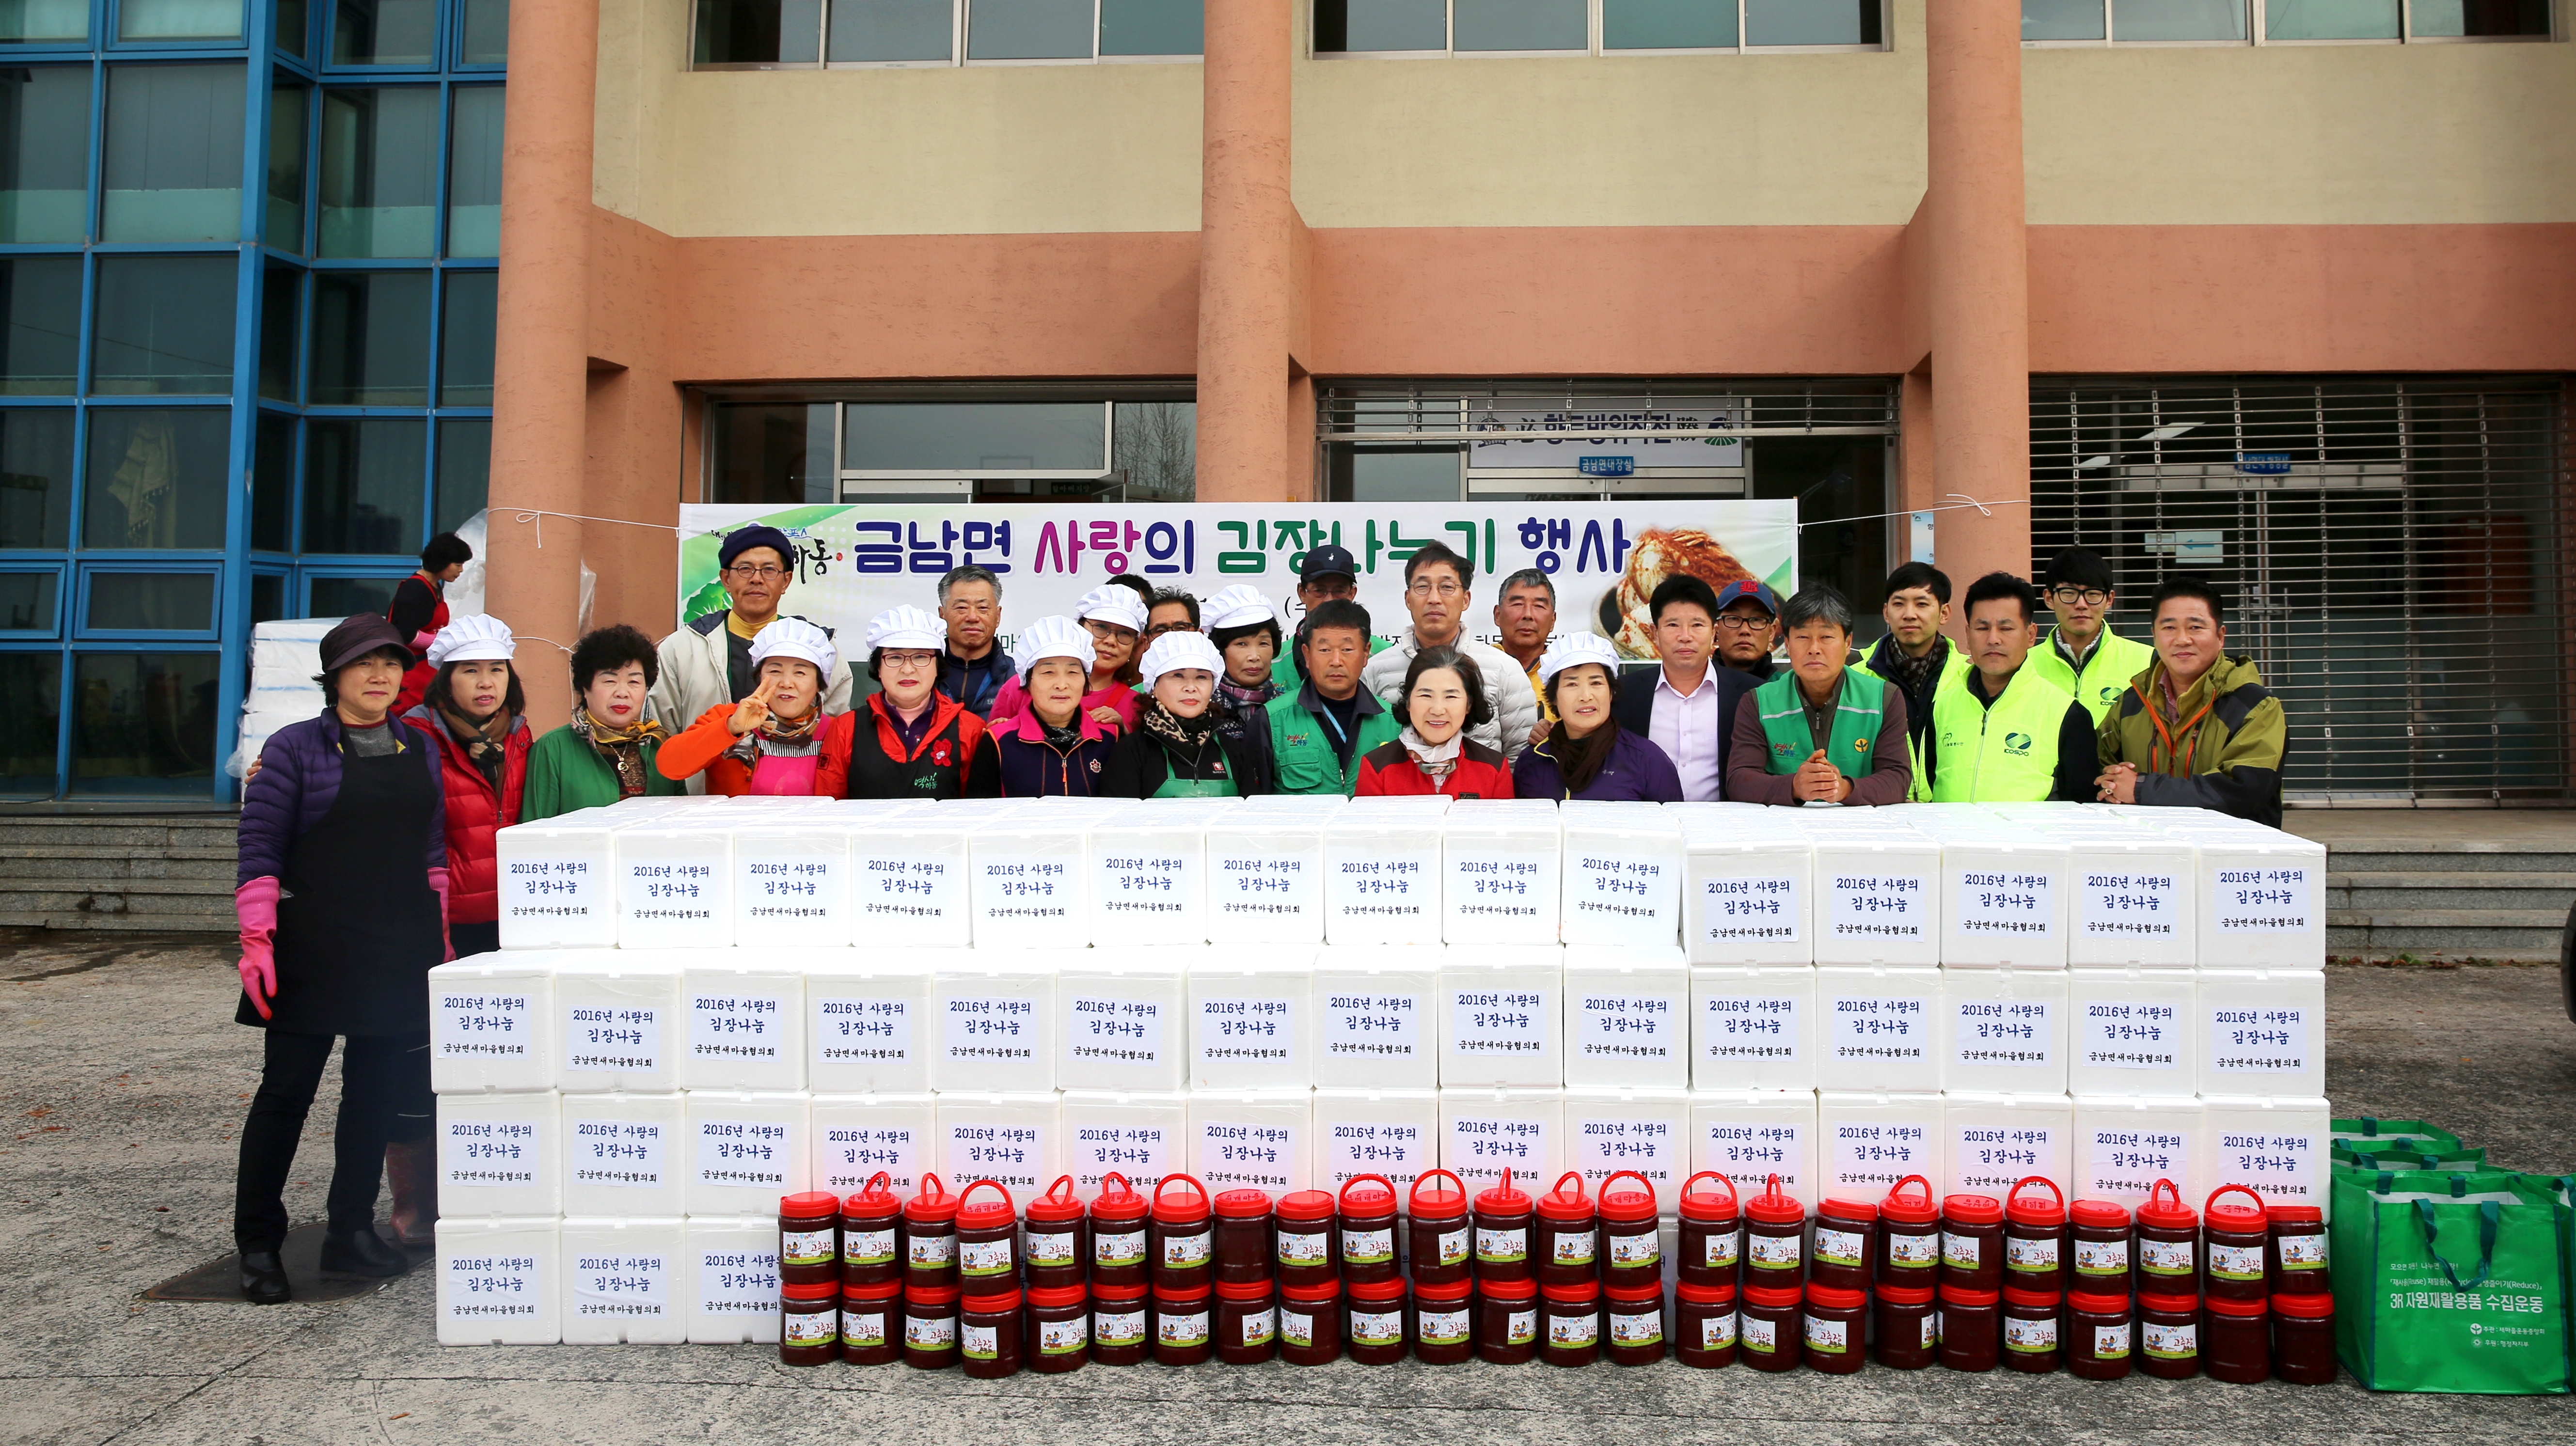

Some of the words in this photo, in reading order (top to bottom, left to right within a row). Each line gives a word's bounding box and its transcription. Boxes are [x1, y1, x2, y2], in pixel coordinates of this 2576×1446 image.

[1581, 458, 1632, 472] 금남면대장실
[855, 520, 1011, 574] 금남면
[1035, 519, 1194, 575] 사랑의
[1518, 517, 1631, 575] 행사
[914, 772, 937, 789] 역시!
[925, 781, 938, 790] 하동
[511, 863, 548, 875] 2016년
[554, 862, 586, 875] 사랑의
[751, 863, 787, 876] 2016년
[793, 864, 826, 876] 사랑의
[987, 864, 1024, 876] 2016년
[1030, 864, 1062, 876] 사랑의
[1224, 860, 1261, 872] 2016년
[1268, 861, 1300, 873] 사랑의
[1342, 862, 1379, 874] 2016년
[1386, 862, 1418, 874] 사랑의
[1965, 874, 2005, 887] 2016년
[2011, 875, 2047, 889] 사랑의
[2220, 871, 2260, 884] 2016년
[2267, 870, 2302, 884] 사랑의
[525, 880, 577, 894] 김장나눔
[765, 881, 816, 895] 김장나눔
[1002, 881, 1054, 896] 김장나눔
[1238, 877, 1290, 892] 김장나눔
[1357, 880, 1408, 894] 김장나눔
[1708, 881, 1748, 895] 2016년
[1754, 880, 1789, 894] 사랑의
[1979, 893, 2036, 909] 김장나눔
[2236, 890, 2293, 905] 김장나눔
[511, 907, 587, 916] 금남면새마을협의회
[750, 907, 825, 917] 금남면새마을협의회
[989, 908, 1064, 917] 금남면새마을협의회
[1226, 903, 1299, 913] 금남면새마을협의회
[1343, 906, 1419, 915] 금남면새마을협의회
[1724, 899, 1780, 915] 김장나눔
[1963, 920, 2045, 932] 금남면새마을협의회
[2221, 917, 2304, 927] 금남면새마을협의회
[1710, 927, 1791, 938] 금남면새마을협의회
[444, 997, 483, 1010] 2016년
[490, 997, 524, 1011] 사랑의
[696, 998, 735, 1012] 2016년
[741, 1000, 775, 1013] 사랑의
[1458, 994, 1498, 1007] 2016년
[1504, 994, 1539, 1007] 사랑의
[1710, 1000, 1749, 1013] 2016년
[1756, 1000, 1791, 1014] 사랑의
[950, 1001, 989, 1014] 2016년
[996, 1002, 1030, 1015] 사랑의
[1205, 1002, 1245, 1015] 2016년
[1251, 1002, 1286, 1015] 사랑의
[1962, 1004, 2002, 1018] 2016년
[2008, 1005, 2044, 1018] 사랑의
[458, 1015, 514, 1031] 김장나눔
[1473, 1012, 1529, 1028] 김장나눔
[2216, 1011, 2257, 1024] 2016년
[2263, 1011, 2299, 1024] 사랑의
[710, 1017, 765, 1034] 김장나눔
[965, 1019, 1020, 1035] 김장나눔
[1220, 1021, 1276, 1036] 김장나눔
[1725, 1018, 1781, 1034] 김장나눔
[1977, 1022, 2034, 1038] 김장나눔
[2232, 1030, 2290, 1045] 김장나눔
[443, 1043, 523, 1054] 금남면새마을협의회
[695, 1044, 774, 1057] 금남면새마을협의회
[1458, 1040, 1539, 1051] 금남면새마을협의회
[1710, 1046, 1791, 1056] 금남면새마을협의회
[950, 1047, 1030, 1058] 금남면새마을협의회
[1205, 1048, 1286, 1058] 금남면새마을협의회
[1961, 1050, 2043, 1061] 금남면새마을협의회
[2217, 1058, 2300, 1068] 금남면새마을협의회
[452, 1124, 491, 1137] 2016년
[497, 1124, 531, 1138] 사랑의
[579, 1124, 617, 1138] 2016년
[623, 1125, 658, 1140] 사랑의
[704, 1124, 743, 1138] 2016년
[749, 1126, 783, 1140] 사랑의
[1335, 1126, 1375, 1140] 2016년
[1381, 1127, 1416, 1140] 사랑의
[466, 1143, 522, 1159] 김장나눔
[593, 1143, 648, 1160] 김장나눔
[717, 1143, 773, 1160] 김장나눔
[1350, 1145, 1406, 1161] 김장나눔
[451, 1170, 531, 1181] 금남면새마을협의회
[577, 1169, 657, 1183] 금남면새마을협의회
[702, 1170, 782, 1183] 금남면새마을협의회
[811, 1241, 831, 1252] 고추장
[871, 1241, 892, 1252] 고추장
[1049, 1246, 1070, 1257] 고추장
[1123, 1242, 1142, 1254] 고추장
[1302, 1242, 1323, 1254] 고추장
[1502, 1241, 1523, 1252] 고추장
[1778, 1246, 1798, 1257] 고추장
[1837, 1244, 1858, 1256] 고추장
[1953, 1247, 1975, 1258] 고추장
[988, 1250, 1008, 1262] 고추장
[2033, 1252, 2056, 1262] 고추장
[2105, 1253, 2127, 1263] 고추장
[2168, 1254, 2189, 1264] 고추장
[453, 1258, 491, 1272] 2016년
[498, 1257, 533, 1271] 사랑의
[580, 1258, 619, 1271] 2016년
[625, 1258, 660, 1272] 사랑의
[2239, 1259, 2260, 1269] 고추장
[468, 1277, 523, 1292] 김장나눔
[594, 1276, 650, 1292] 김장나눔
[2390, 1293, 2403, 1309] 3R
[2406, 1291, 2481, 1310] 자원재활용품
[2486, 1294, 2543, 1314] 수집운동
[453, 1305, 534, 1315] 금남면새마을협의회
[580, 1304, 661, 1315] 금남면새마을협의회
[814, 1322, 834, 1334] 고추장
[858, 1325, 880, 1336] 고추장
[1187, 1323, 1206, 1335] 고추장
[1448, 1321, 1467, 1333] 고추장
[1640, 1321, 1659, 1333] 고추장
[930, 1328, 951, 1340] 고추장
[2034, 1330, 2054, 1341] 고추장
